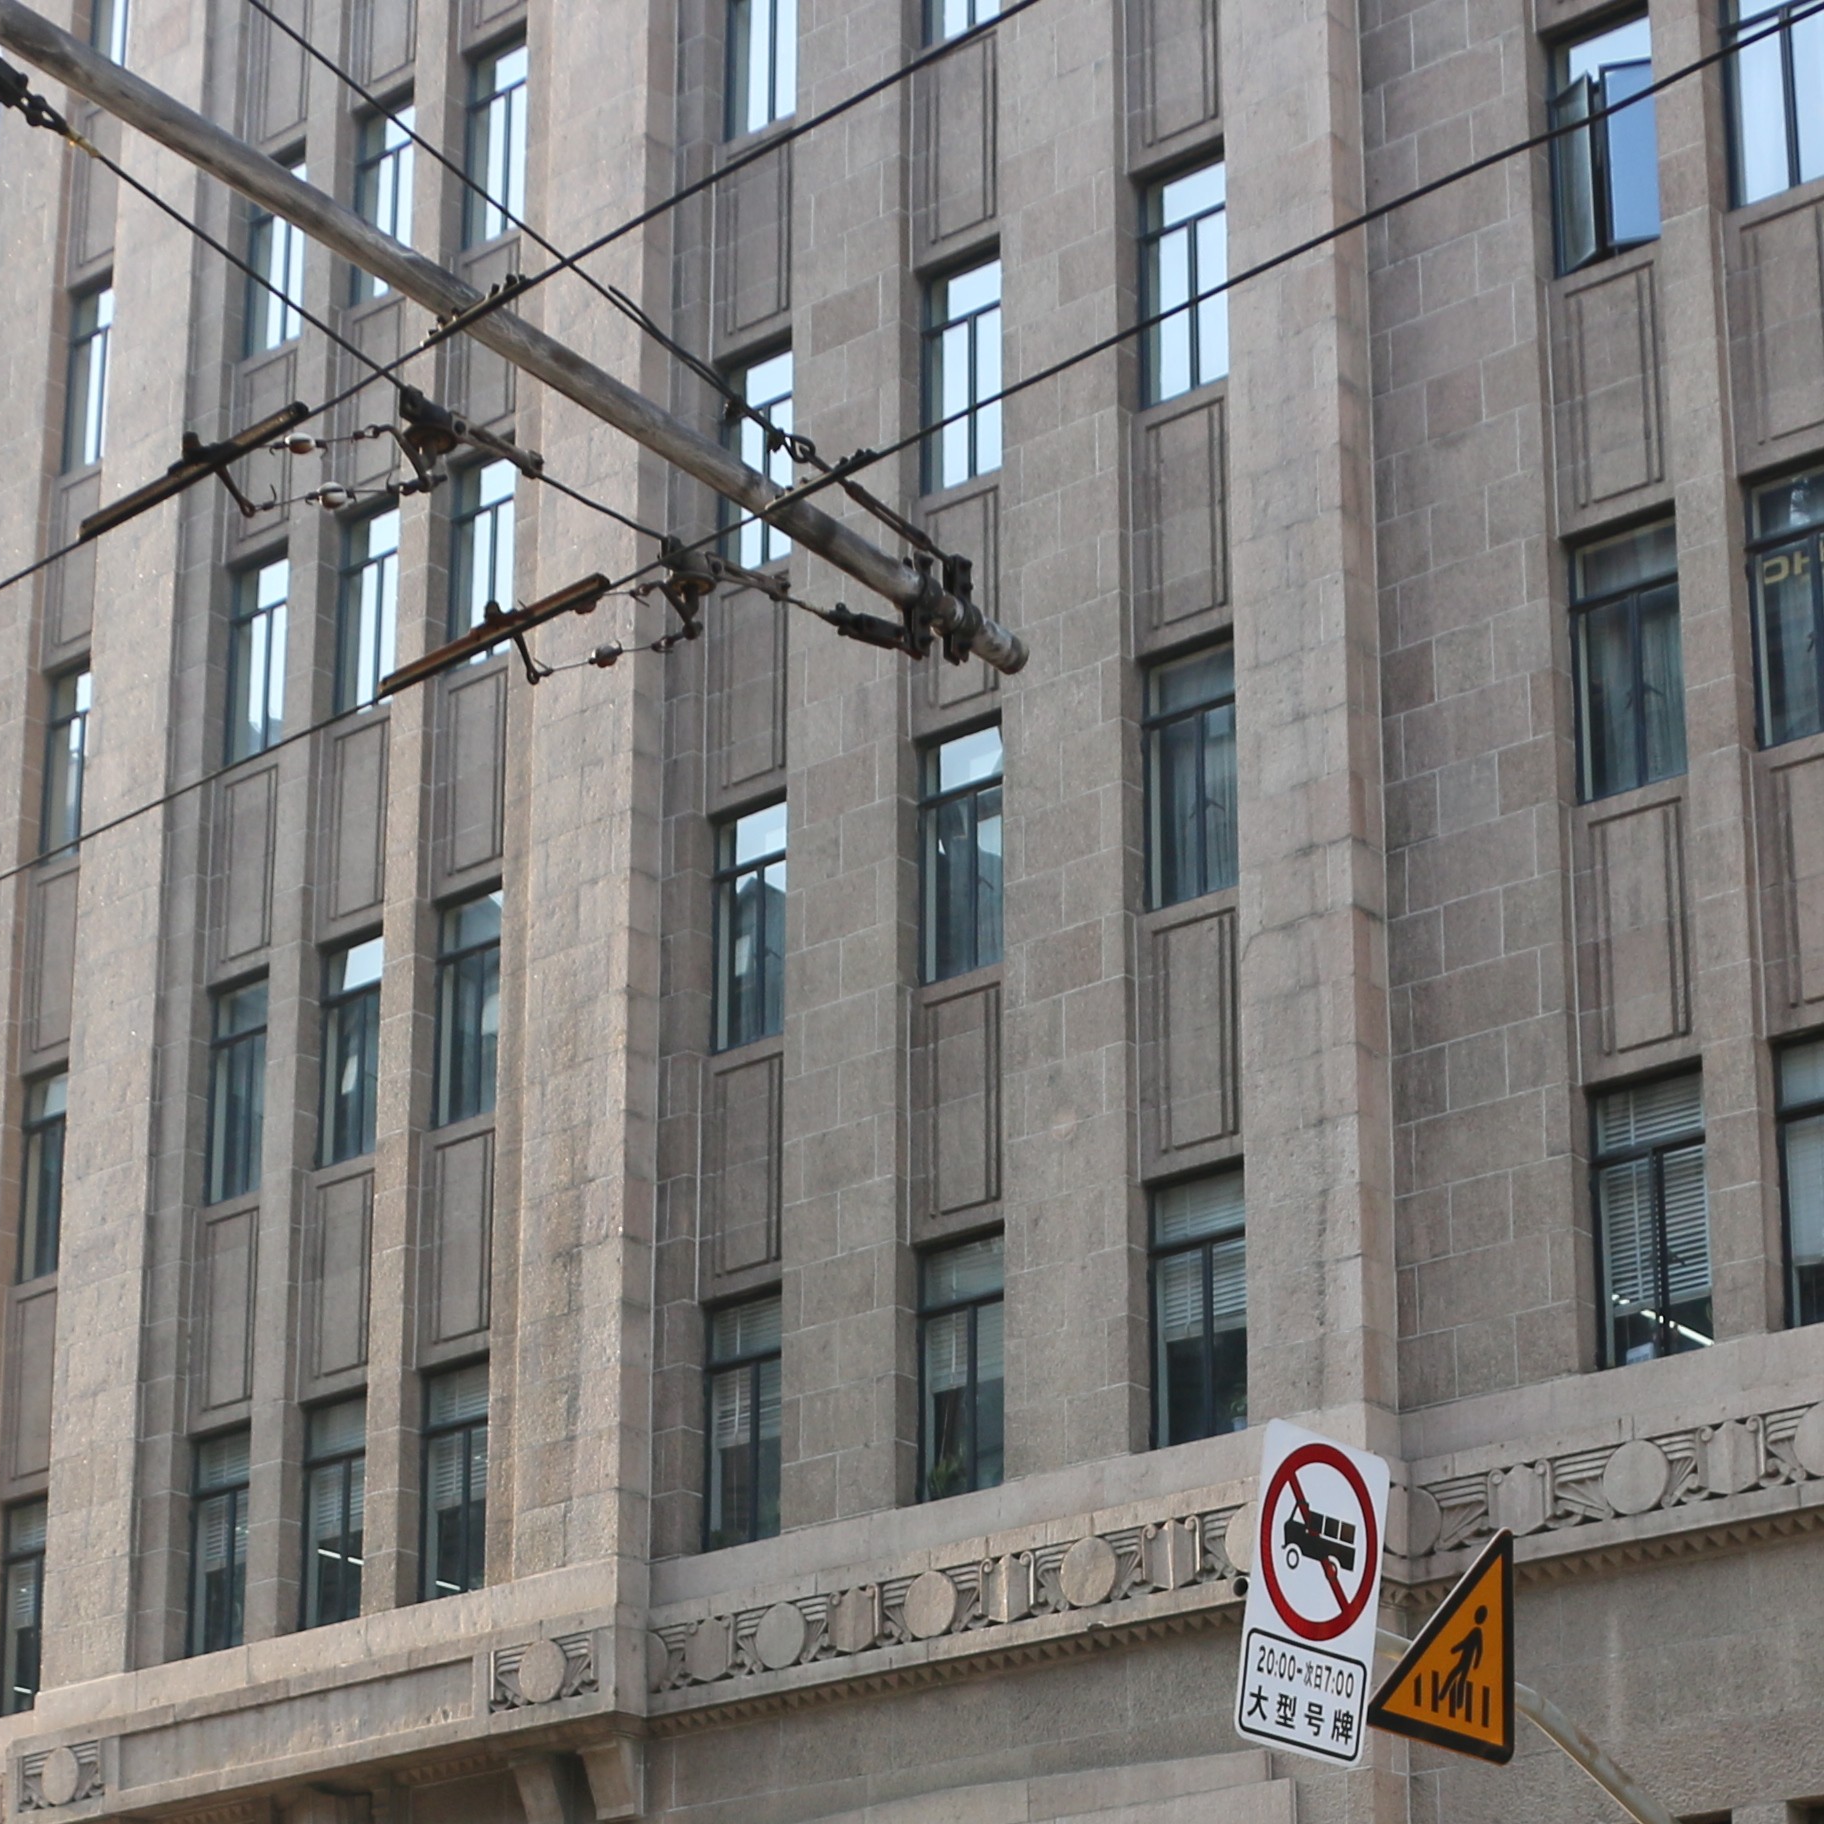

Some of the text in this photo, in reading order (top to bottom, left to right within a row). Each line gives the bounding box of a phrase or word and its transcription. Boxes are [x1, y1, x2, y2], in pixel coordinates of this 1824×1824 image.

[1256, 1644, 1355, 1700] 20:00-次日7:00
[1246, 1684, 1354, 1746] 大型号牌
